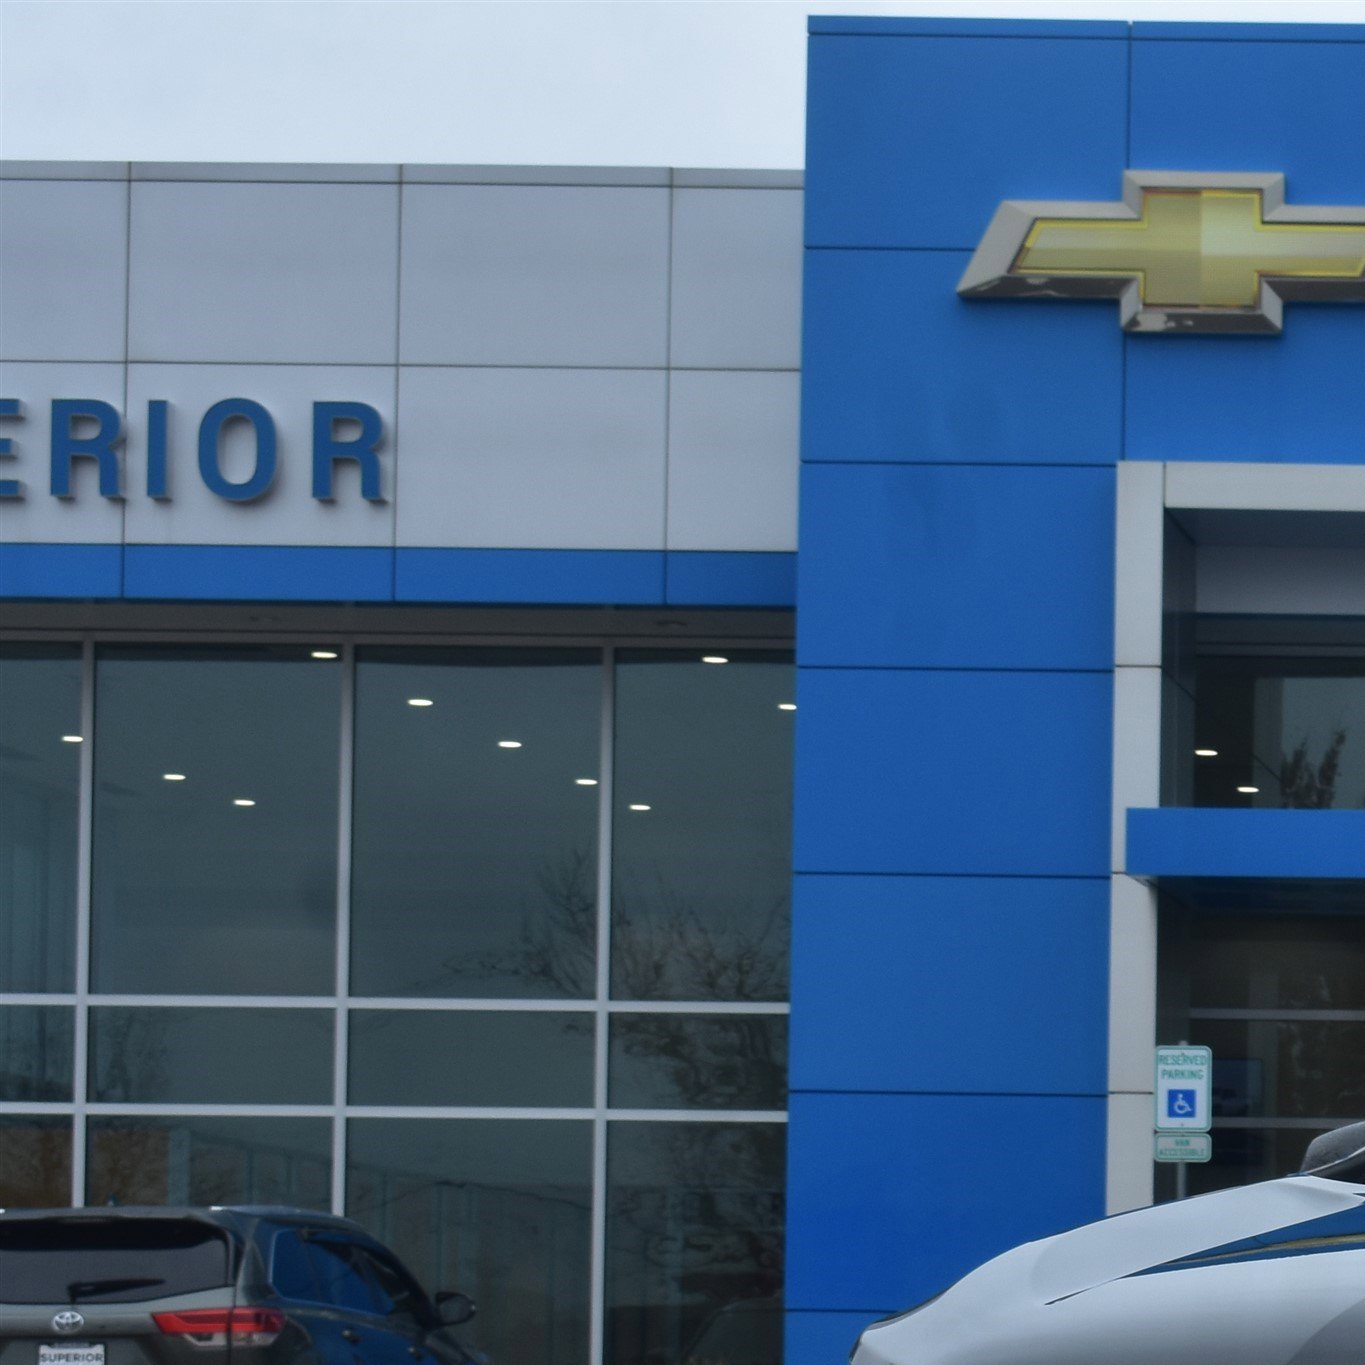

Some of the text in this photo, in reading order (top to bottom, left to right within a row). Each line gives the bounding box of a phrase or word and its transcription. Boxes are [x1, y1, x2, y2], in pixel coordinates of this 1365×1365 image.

[1158, 1055, 1206, 1066] RESERVED
[1161, 1069, 1204, 1080] PARKING
[40, 1353, 104, 1362] SUPERIOR
